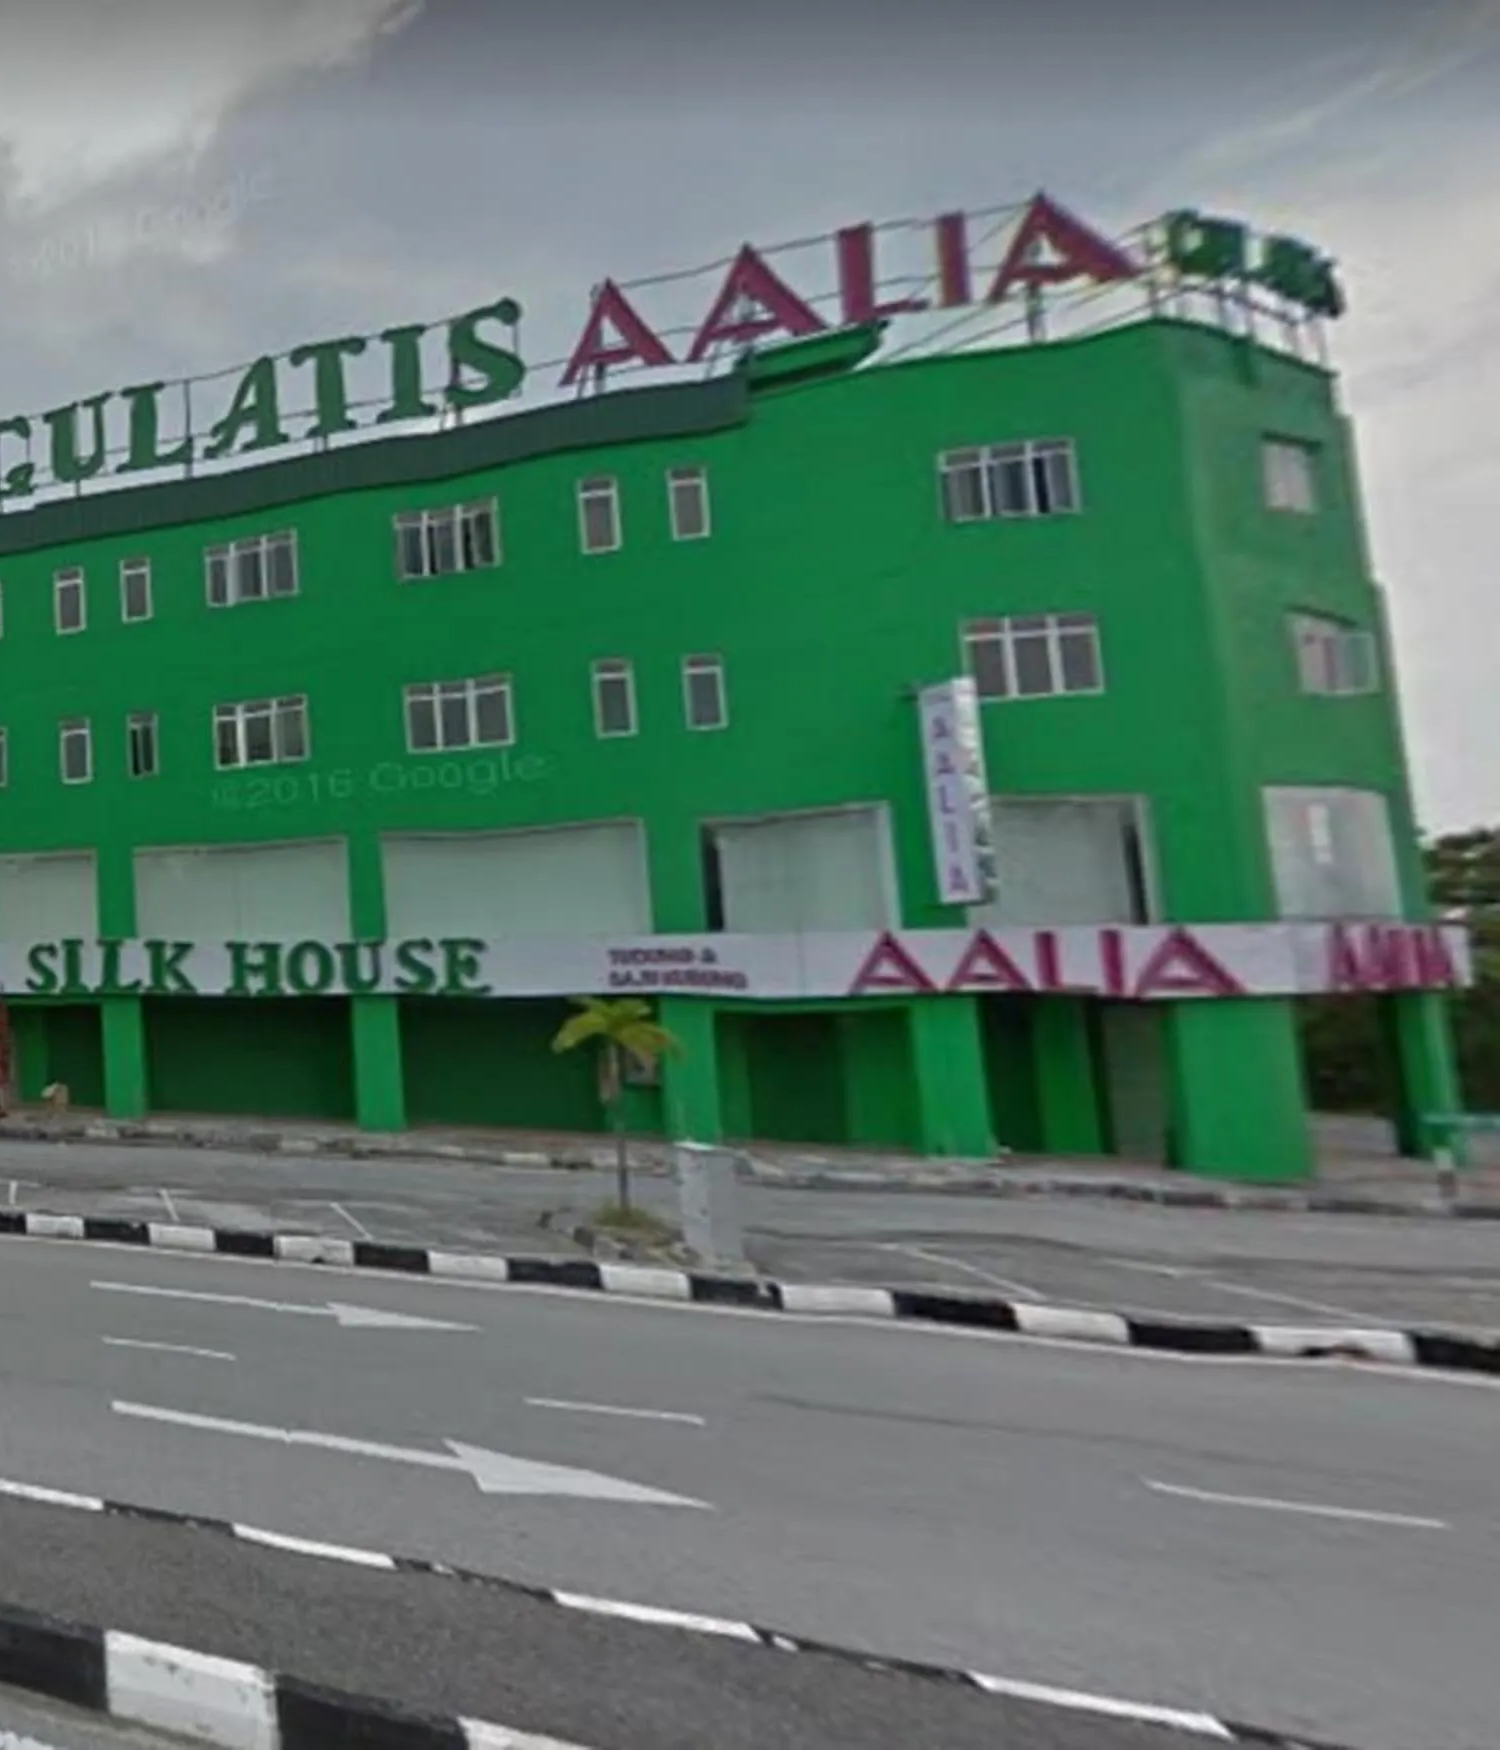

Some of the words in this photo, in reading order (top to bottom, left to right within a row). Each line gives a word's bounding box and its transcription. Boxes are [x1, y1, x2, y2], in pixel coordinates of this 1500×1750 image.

[559, 192, 1144, 387] AALIA
[930, 714, 972, 894] AALIA
[25, 938, 198, 995] SILK
[224, 938, 492, 995] HOUSE
[846, 928, 1248, 996] AALIA
